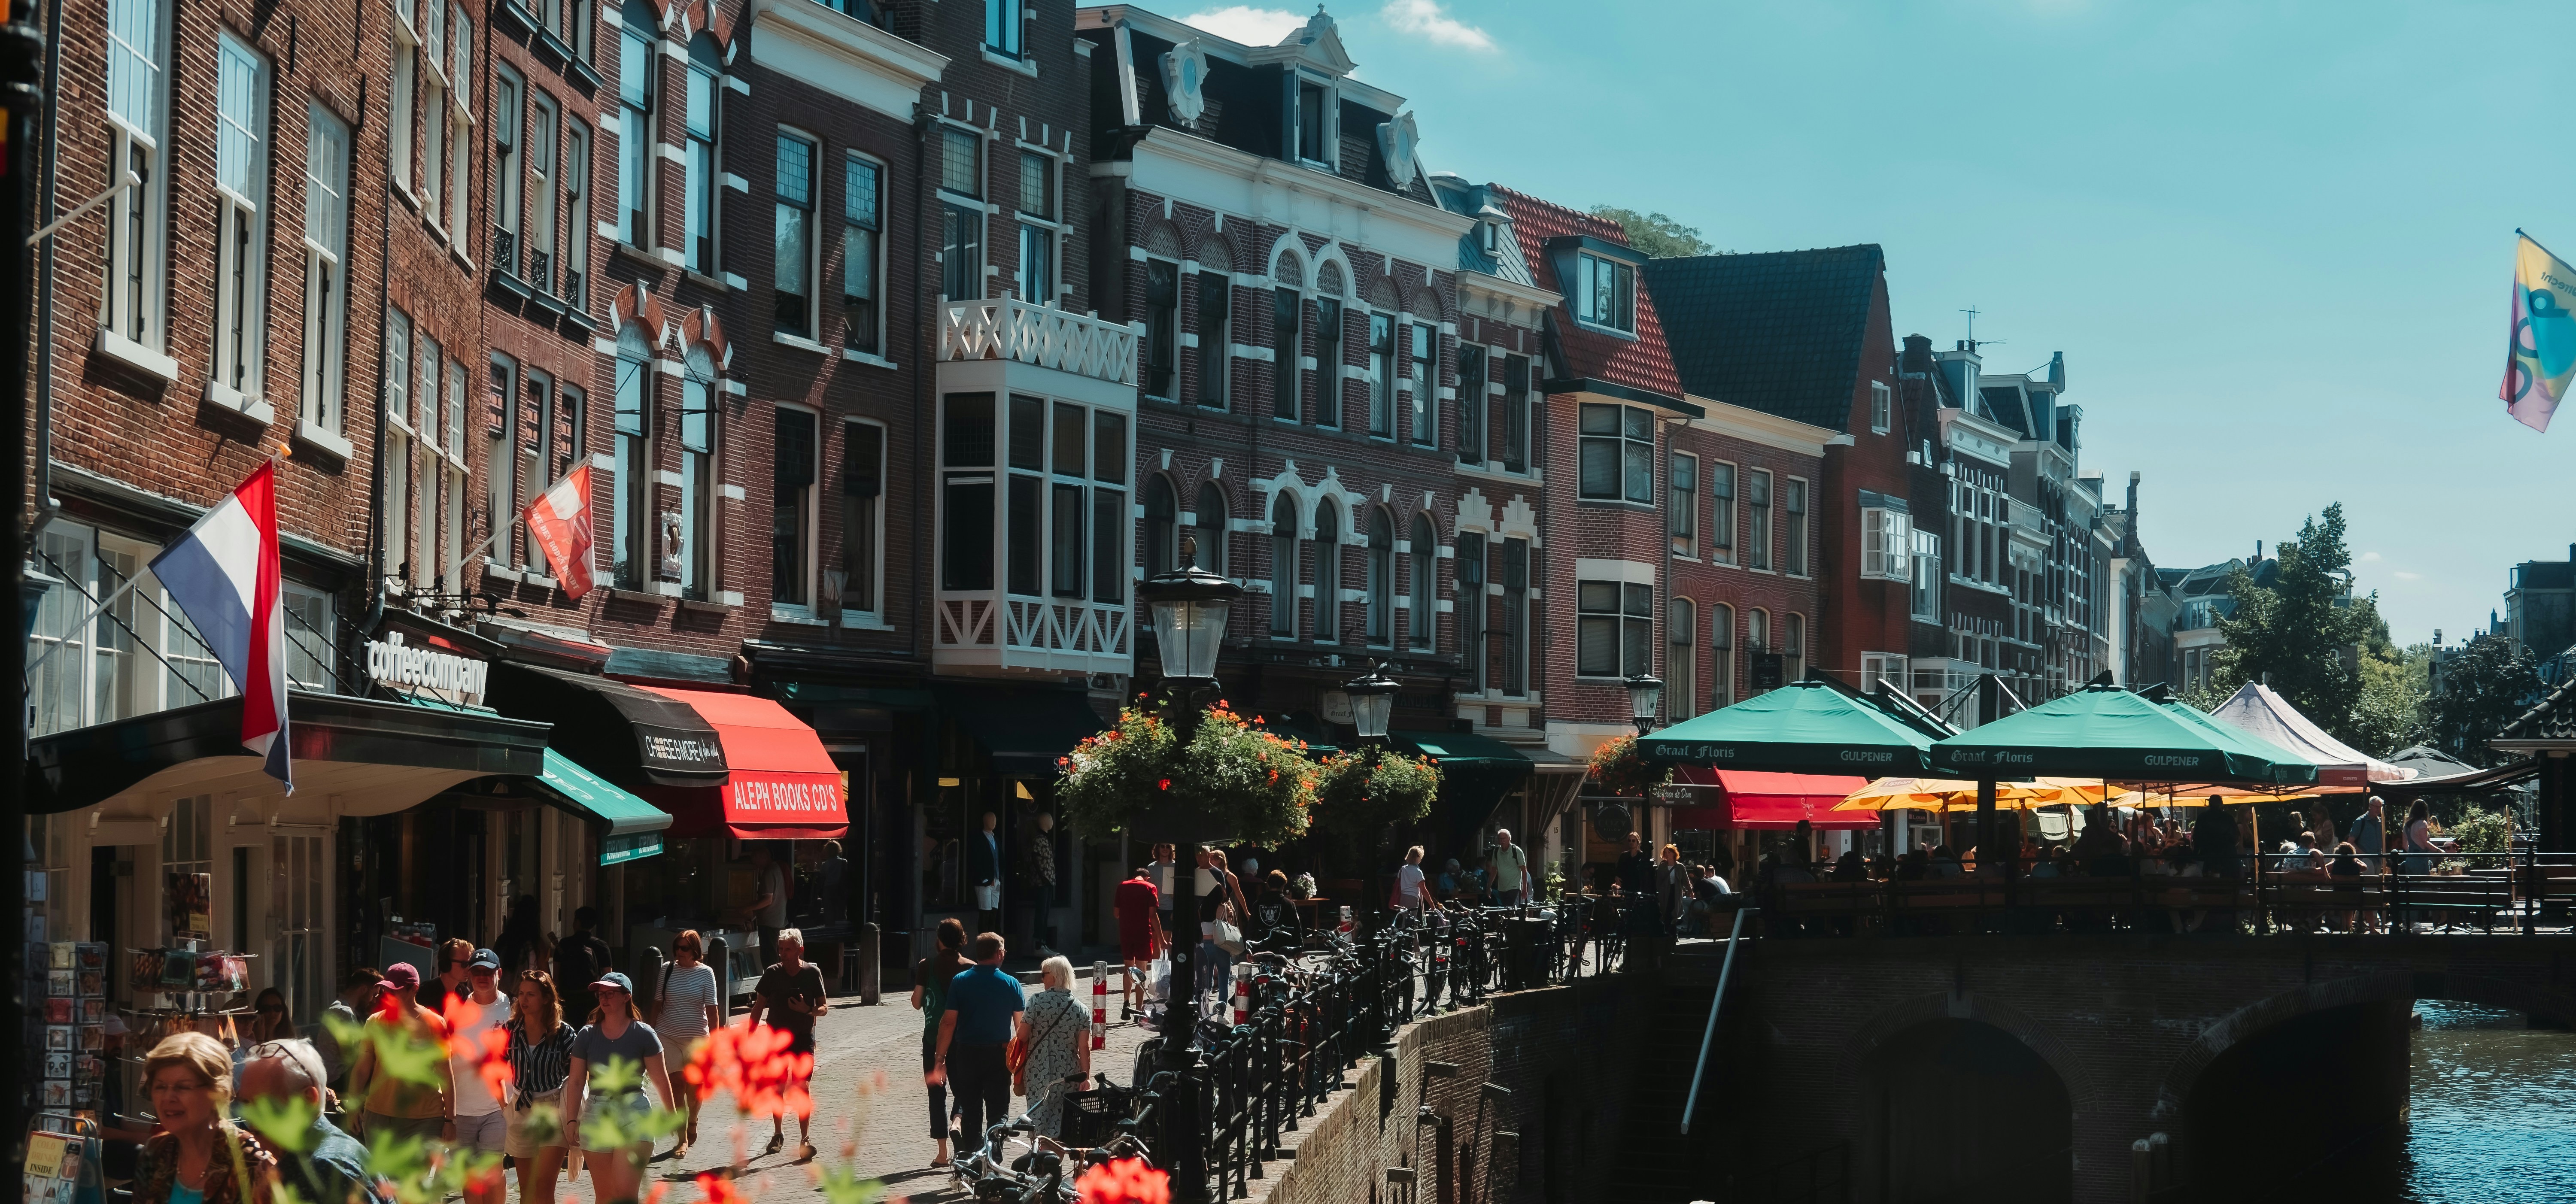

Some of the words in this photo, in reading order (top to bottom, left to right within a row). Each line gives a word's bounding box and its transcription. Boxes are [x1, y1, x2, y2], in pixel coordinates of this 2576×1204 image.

[540, 525, 553, 540] DEN
[368, 631, 488, 706] coffeecompany
[1656, 744, 1689, 755] Graaf
[1695, 745, 1735, 758] Floris
[1841, 750, 1893, 761] GULPENER
[1951, 750, 1986, 762] Graaf
[1992, 751, 2034, 764] Floris
[2144, 755, 2199, 766] GULPENER
[734, 781, 772, 810] ALEPH
[772, 782, 811, 811] BOOKS
[812, 784, 837, 811] CD'S
[1674, 789, 1680, 798] de
[36, 1140, 55, 1149] COLD
[31, 1151, 58, 1162] DRINKS
[30, 1163, 53, 1174] INSIDE
